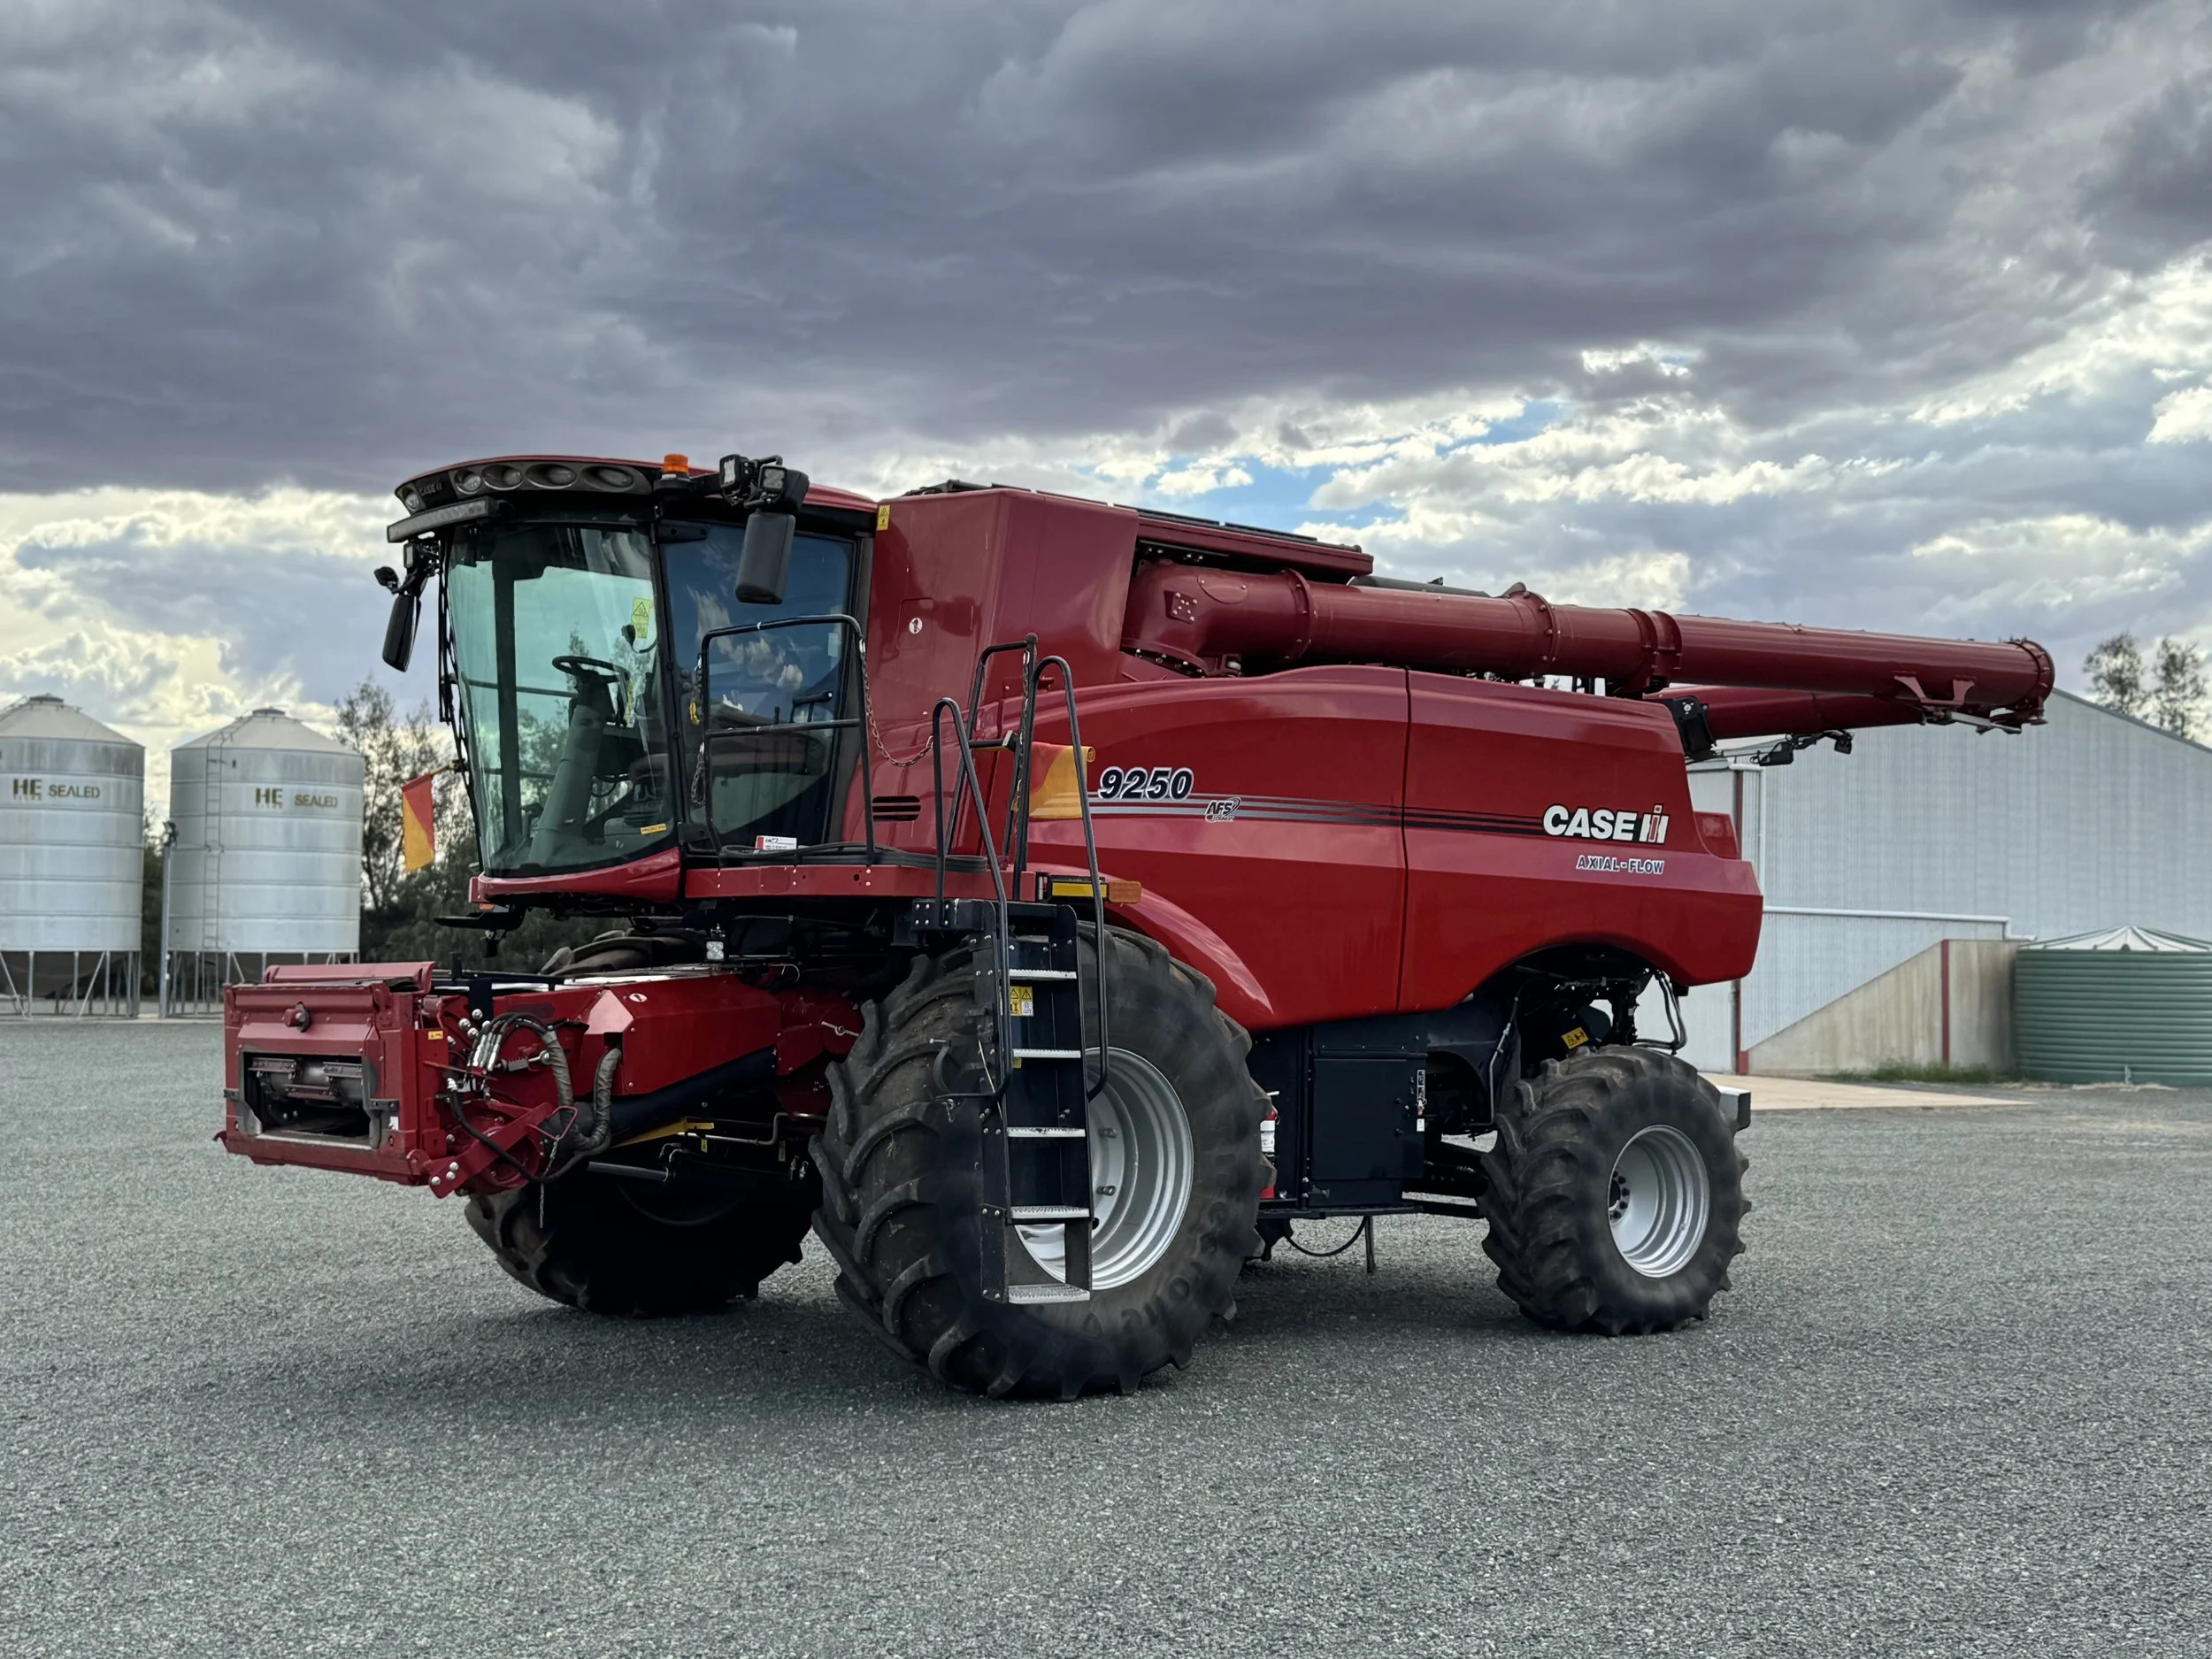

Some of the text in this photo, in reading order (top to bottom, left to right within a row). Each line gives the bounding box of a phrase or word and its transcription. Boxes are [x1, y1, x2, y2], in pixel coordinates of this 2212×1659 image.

[13, 779, 100, 798] HE SEALED
[1098, 766, 1194, 801] 9250
[256, 787, 338, 807] HE SEALED
[1205, 801, 1233, 815] AFS
[1543, 805, 1637, 841] CASE
[1577, 855, 1664, 874] AXIAL-FLOW
